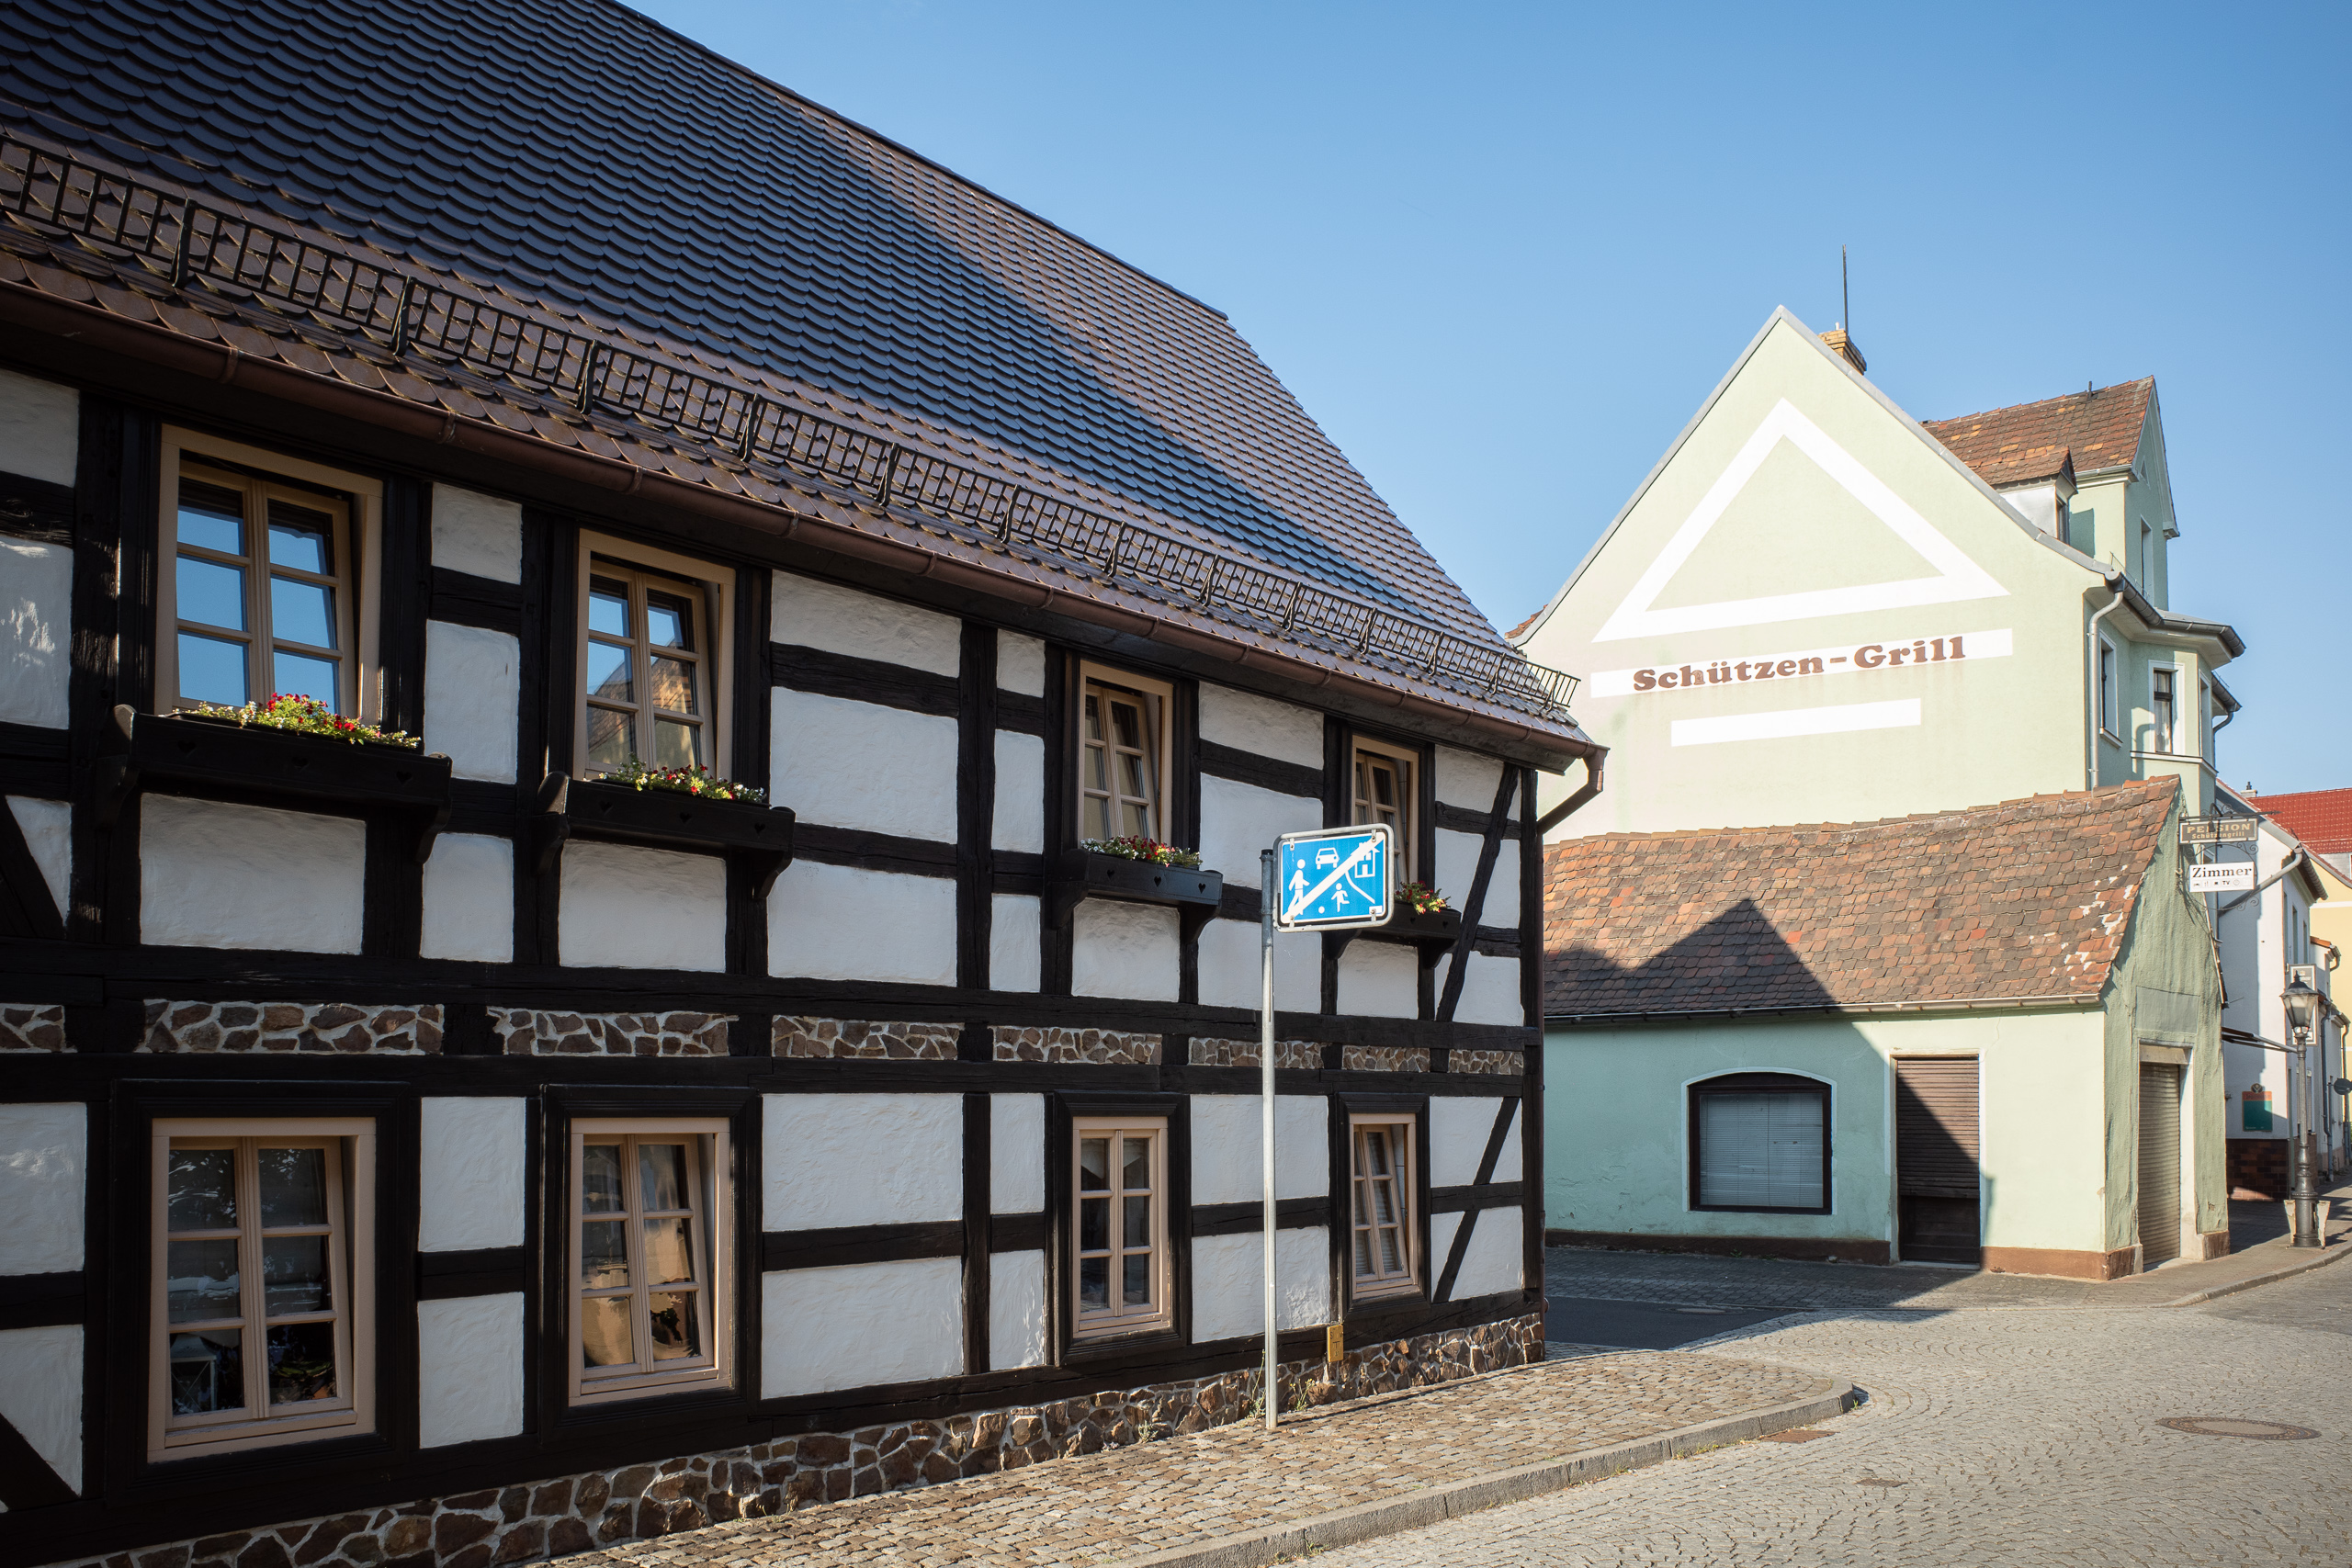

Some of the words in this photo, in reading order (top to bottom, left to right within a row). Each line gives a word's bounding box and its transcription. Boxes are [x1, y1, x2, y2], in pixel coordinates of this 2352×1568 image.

[1633, 636, 1966, 692] Schützen-Grill
[2188, 823, 2250, 833] PESION
[2192, 867, 2252, 878] Zimmer
